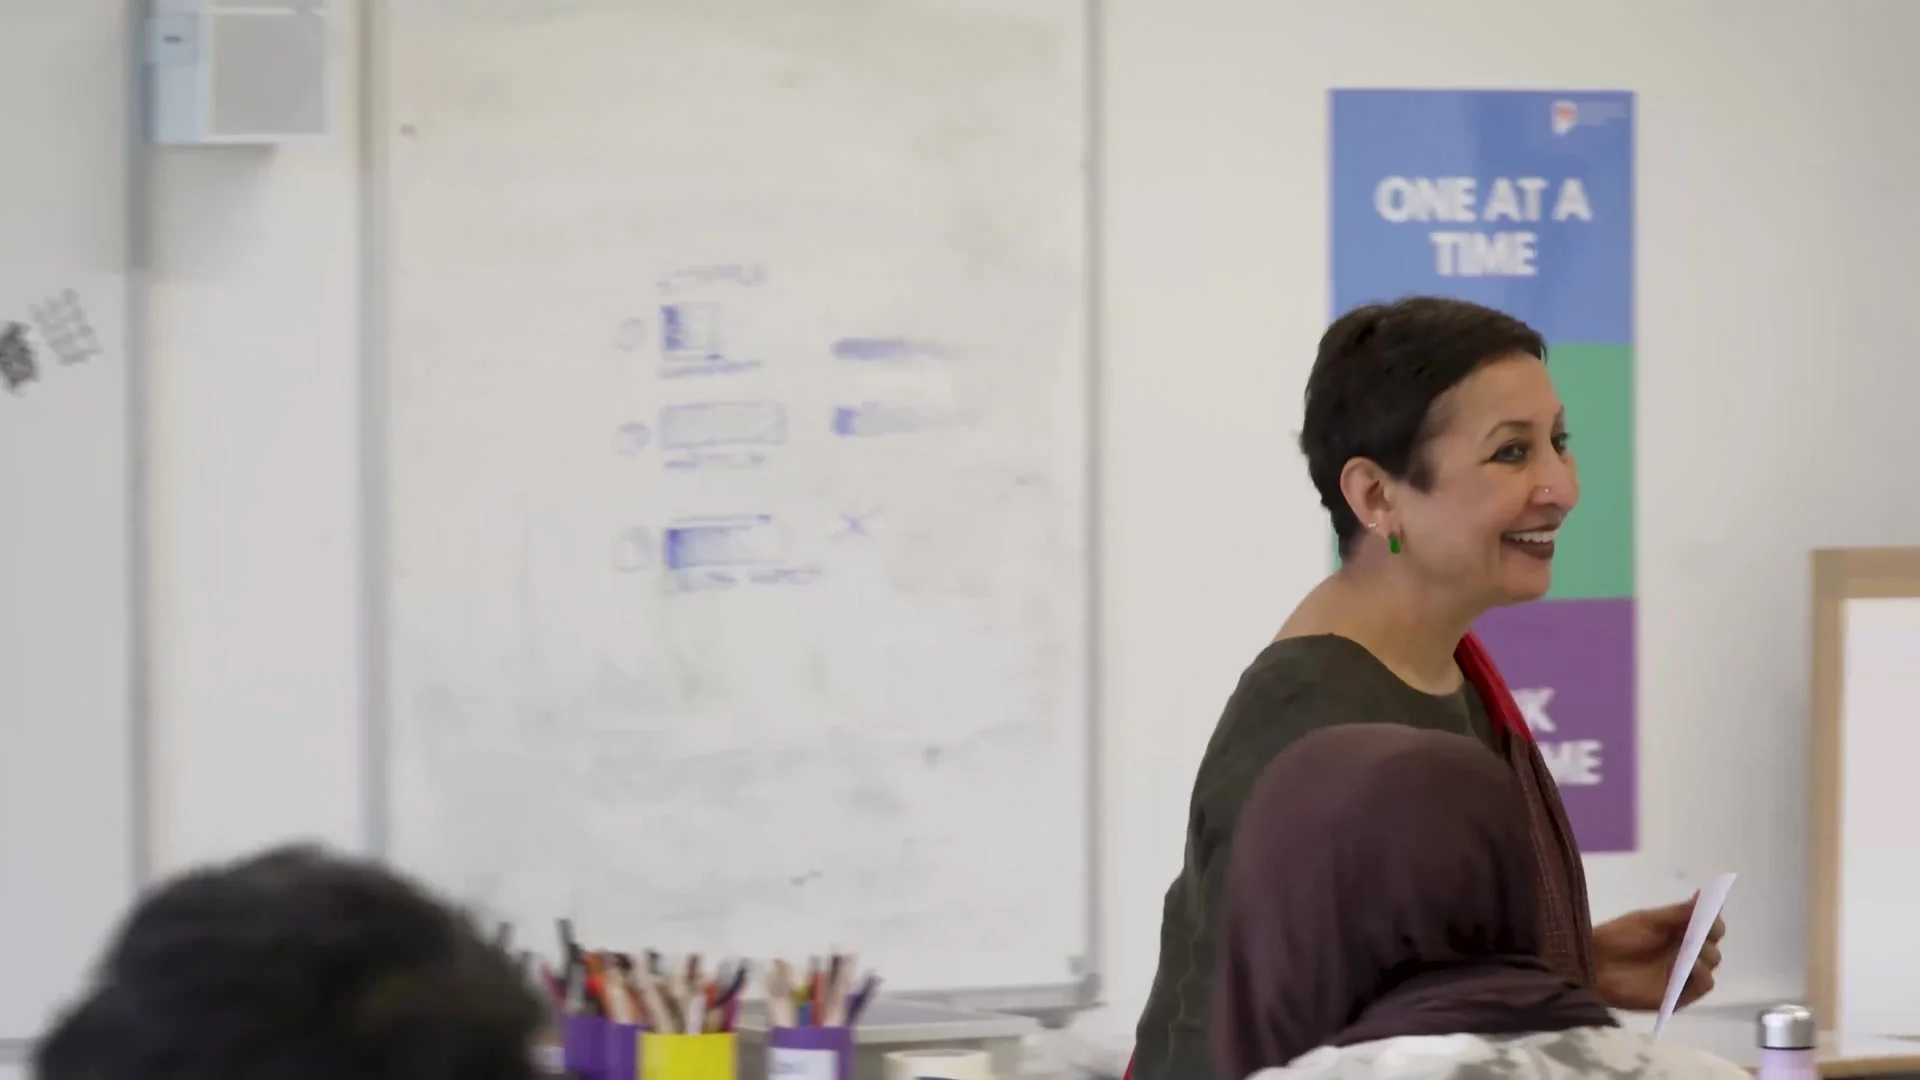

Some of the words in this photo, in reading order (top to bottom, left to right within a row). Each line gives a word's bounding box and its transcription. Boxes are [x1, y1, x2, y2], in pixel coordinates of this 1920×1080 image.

[1376, 175, 1477, 222] ONE
[1484, 177, 1548, 222] AT
[1552, 177, 1593, 222] A
[1430, 232, 1539, 277] TIME
[1537, 740, 1603, 786] ME
